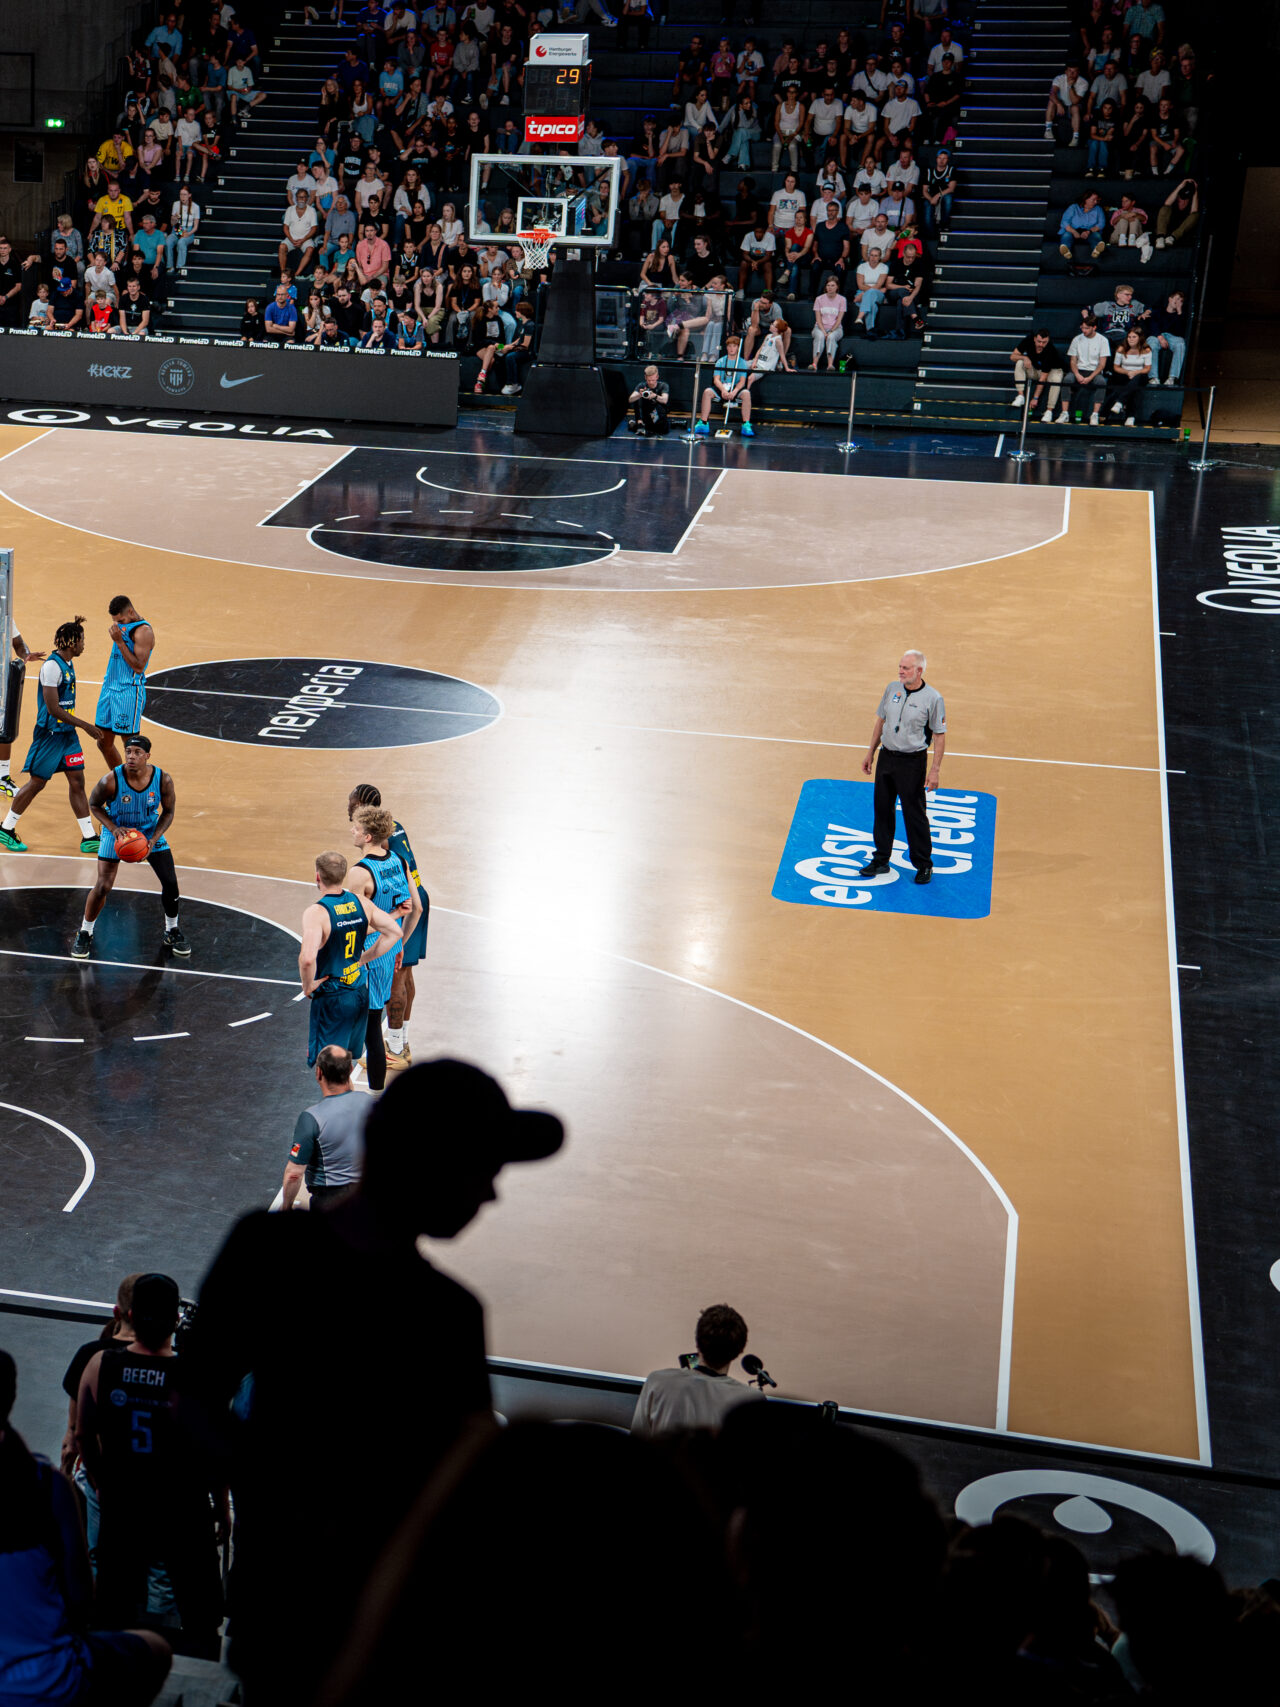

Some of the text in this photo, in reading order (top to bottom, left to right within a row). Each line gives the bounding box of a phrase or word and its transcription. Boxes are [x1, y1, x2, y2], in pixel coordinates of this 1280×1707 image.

[556, 68, 580, 84] 29
[528, 120, 576, 137] tipico
[9, 328, 38, 336] PrimeLED
[43, 329, 72, 338] PrimeLED
[77, 331, 106, 340] PrimeLED
[110, 333, 140, 342] PrimeLED
[145, 335, 174, 343] PrimeLED
[179, 337, 209, 345] PrimeLED
[214, 339, 244, 347] PrimeLED
[249, 341, 279, 349] PrimeLED
[284, 343, 314, 351] PrimeLED
[319, 345, 350, 353] PrimeLED
[355, 347, 385, 355] PrimeLED
[390, 349, 421, 357] PrimeLED
[426, 351, 457, 359] PrimeLED
[105, 415, 334, 439] VEOLIA
[1220, 526, 1280, 586] VEOLIA
[258, 665, 364, 740] nexperia
[345, 930, 357, 959] 27
[122, 1367, 166, 1387] BEECH
[131, 1410, 153, 1453] 5
